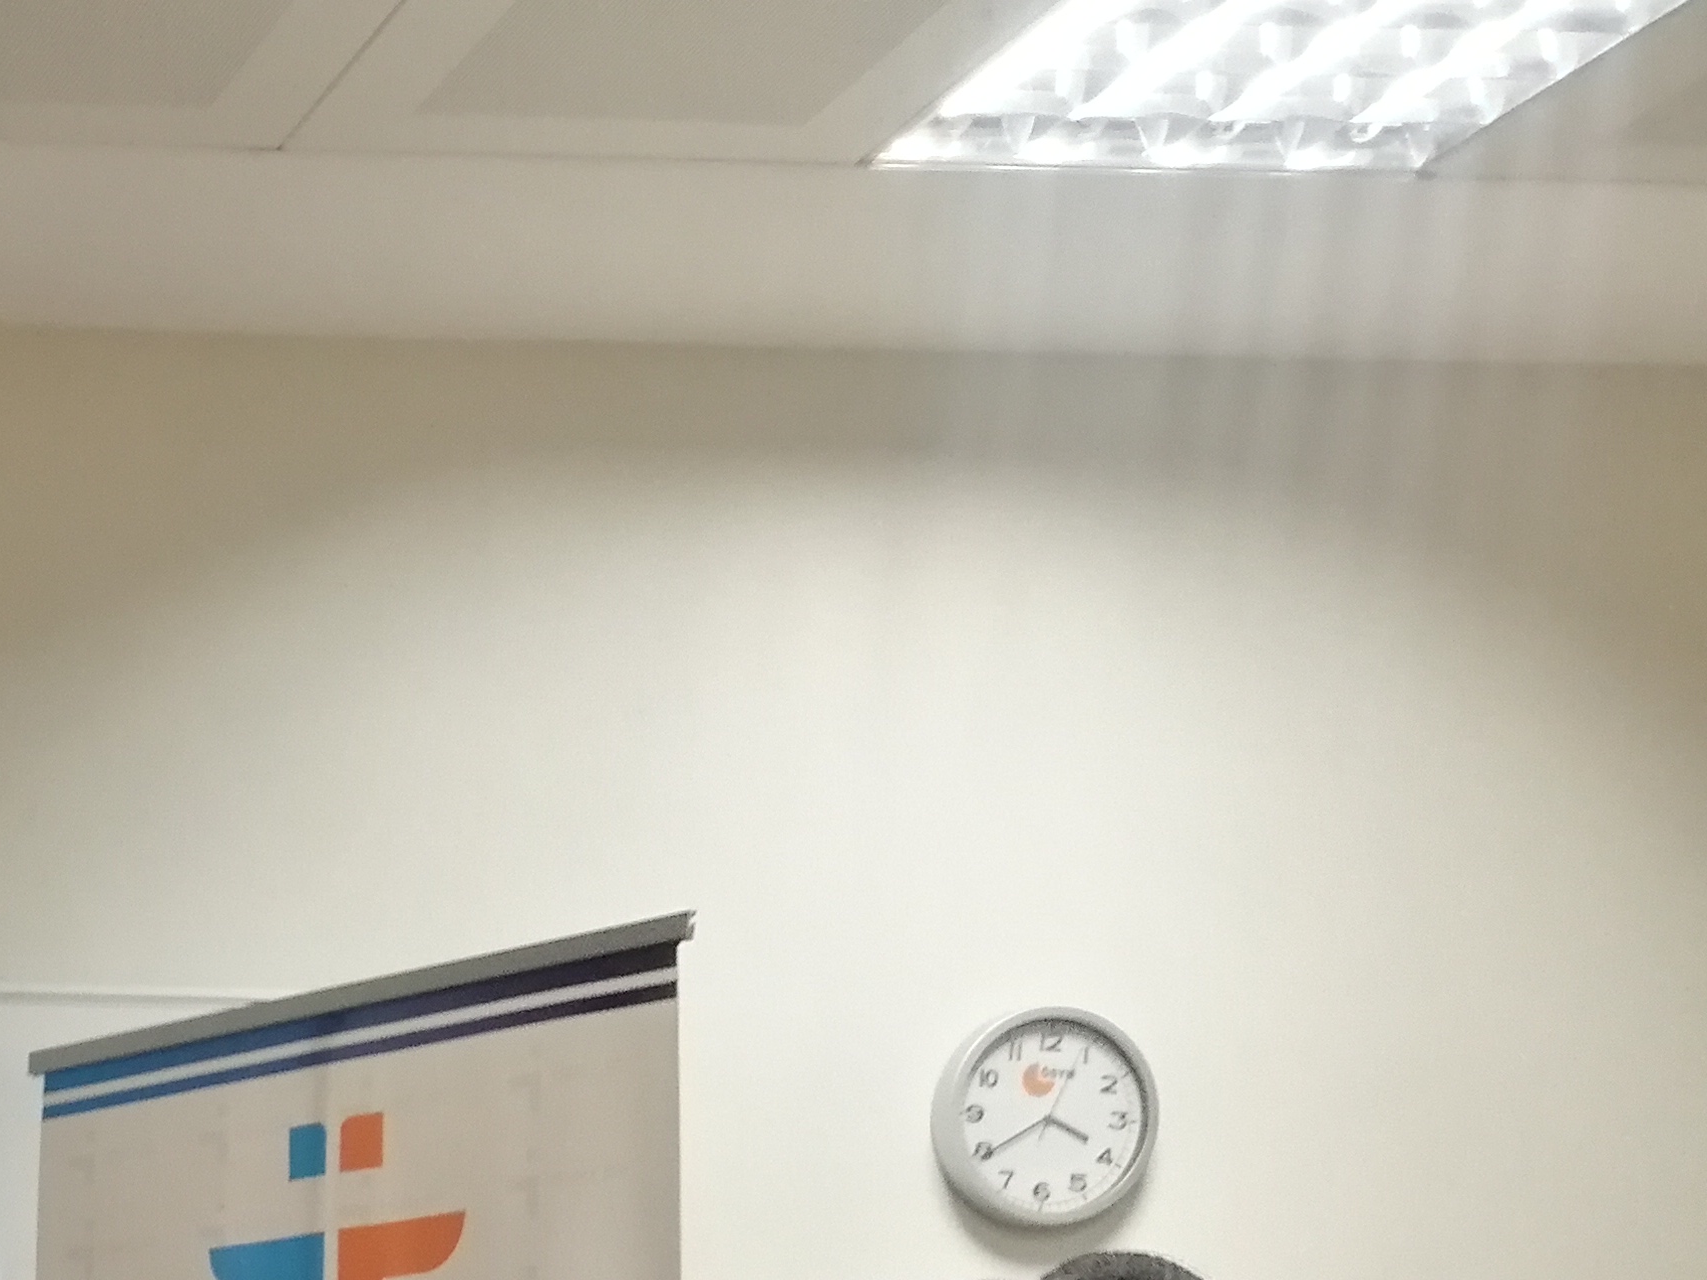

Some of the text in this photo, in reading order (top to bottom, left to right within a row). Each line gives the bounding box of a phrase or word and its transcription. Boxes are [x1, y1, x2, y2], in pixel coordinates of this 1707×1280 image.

[978, 1068, 999, 1089] 10
[1100, 1074, 1118, 1095] 2
[1108, 1111, 1128, 1131] 3
[1096, 1147, 1113, 1166] 4
[998, 1170, 1014, 1189] 7
[1070, 1173, 1087, 1192] 5
[1033, 1182, 1050, 1202] 6
